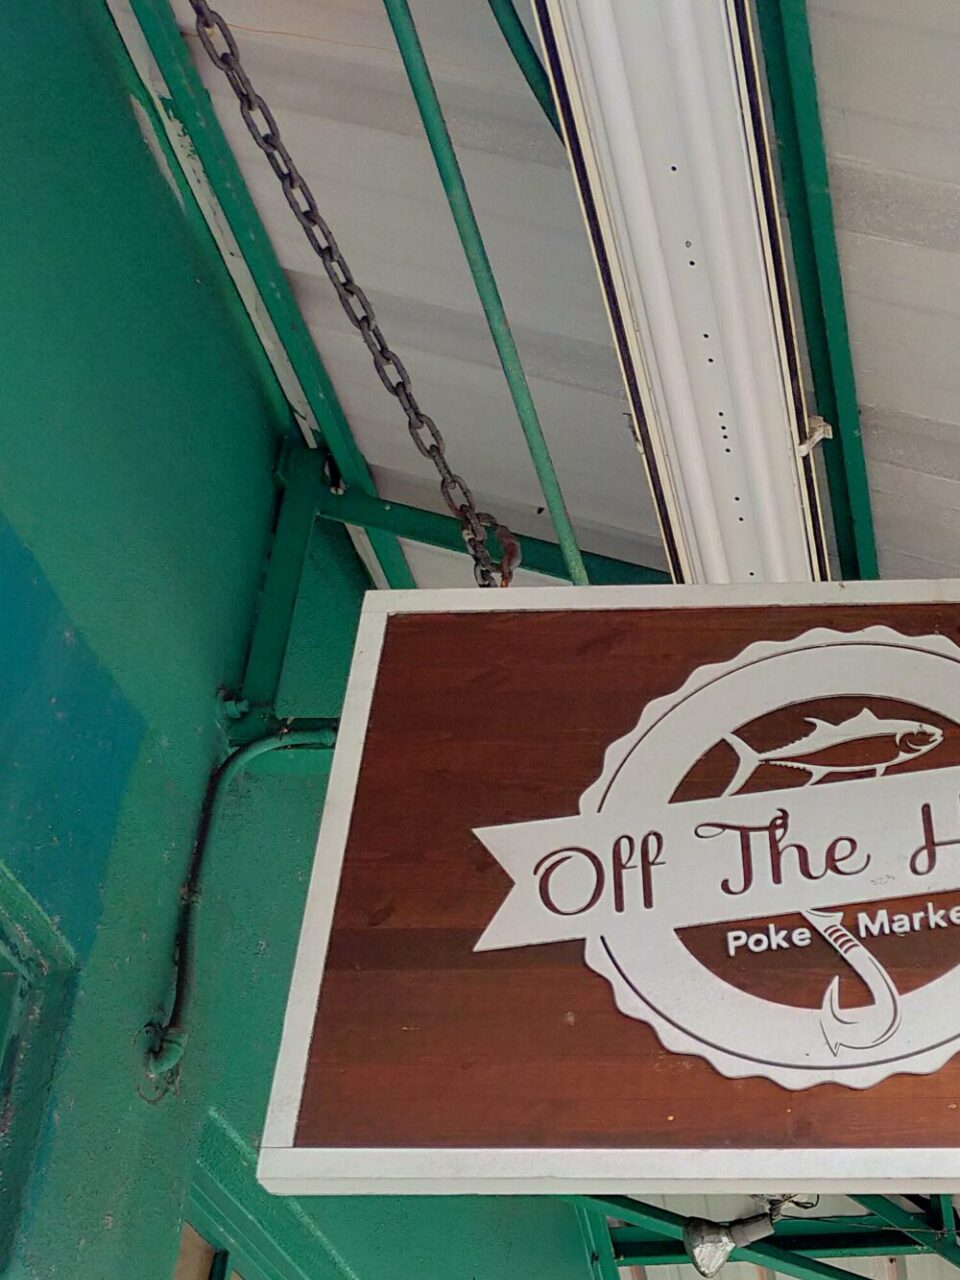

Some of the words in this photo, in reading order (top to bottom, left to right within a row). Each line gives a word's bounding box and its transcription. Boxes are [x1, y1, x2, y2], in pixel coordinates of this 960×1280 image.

[533, 829, 667, 914] Off
[694, 808, 872, 896] The
[726, 923, 813, 958] Poke
